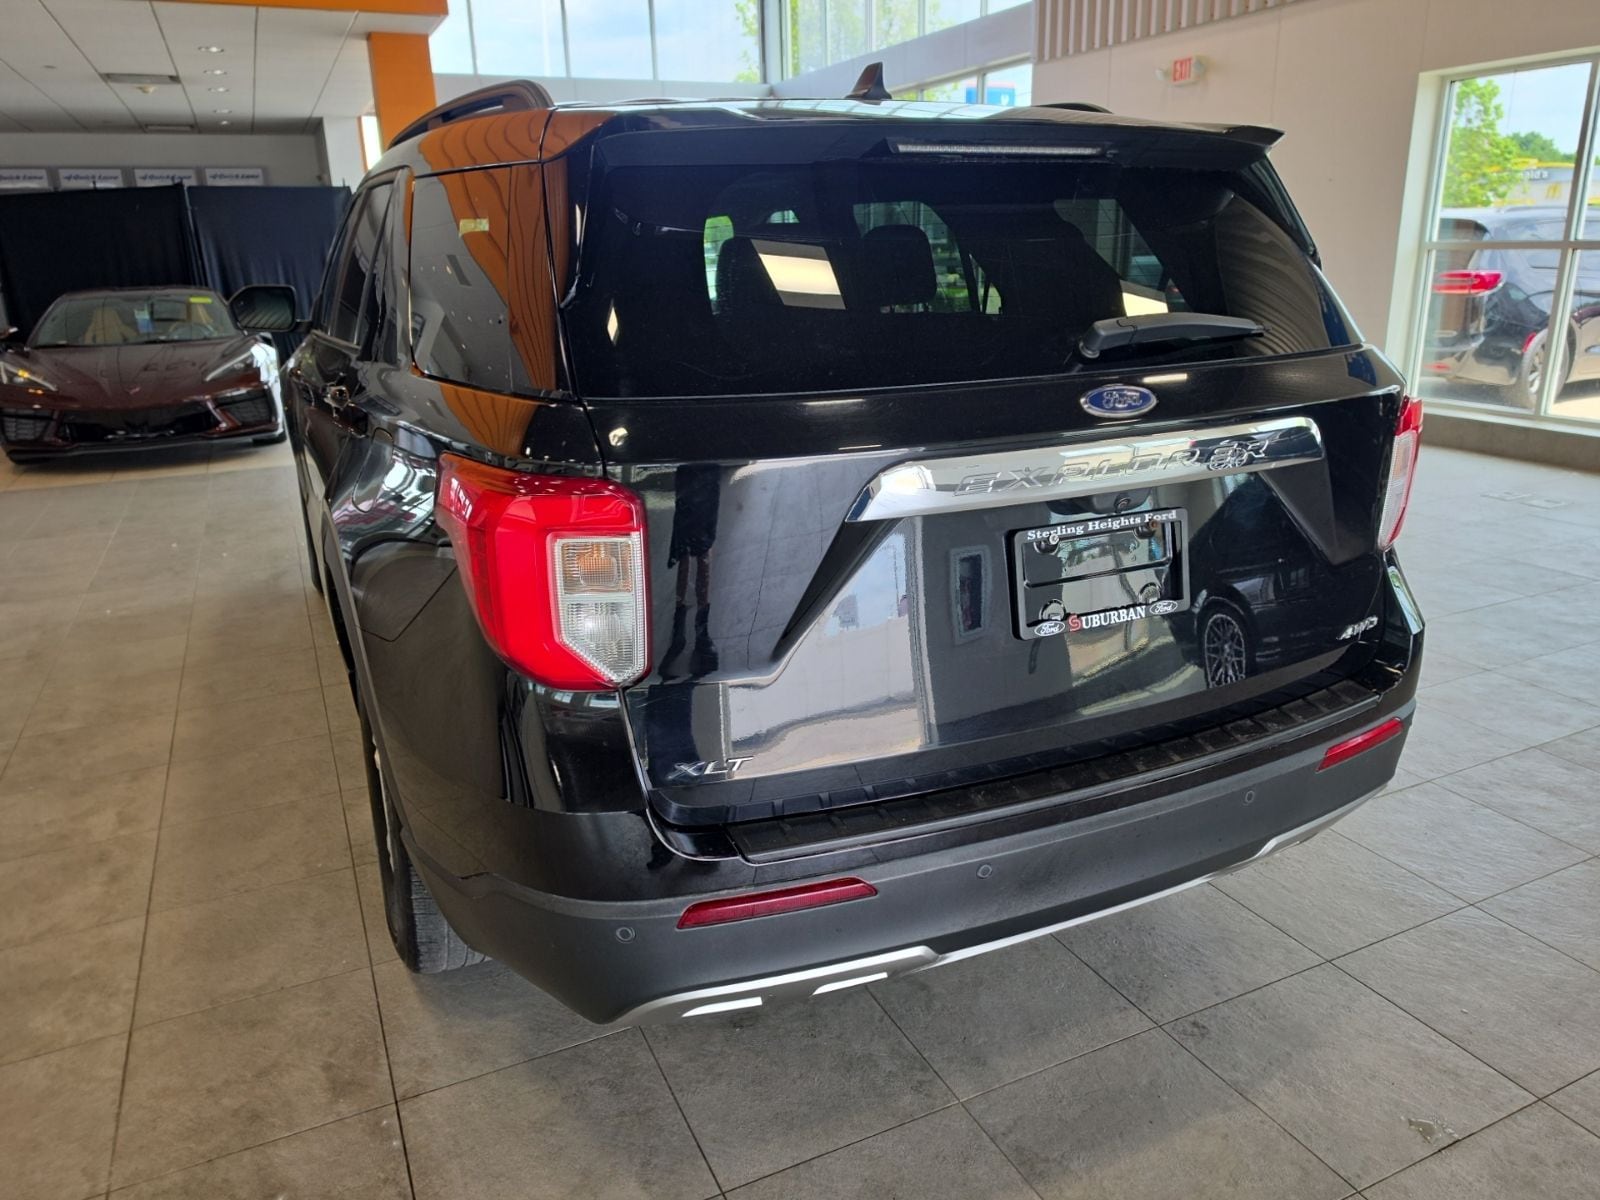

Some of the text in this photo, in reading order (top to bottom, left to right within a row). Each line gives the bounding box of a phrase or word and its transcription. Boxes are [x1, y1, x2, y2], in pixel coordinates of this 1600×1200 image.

[1173, 58, 1192, 82] EXIT
[953, 439, 1269, 498] EXPLORER
[1027, 510, 1177, 541] Sterling Heights Ford
[1068, 605, 1147, 632] SUBURBAN
[1335, 615, 1378, 641] AWD
[666, 755, 755, 780] XLT
